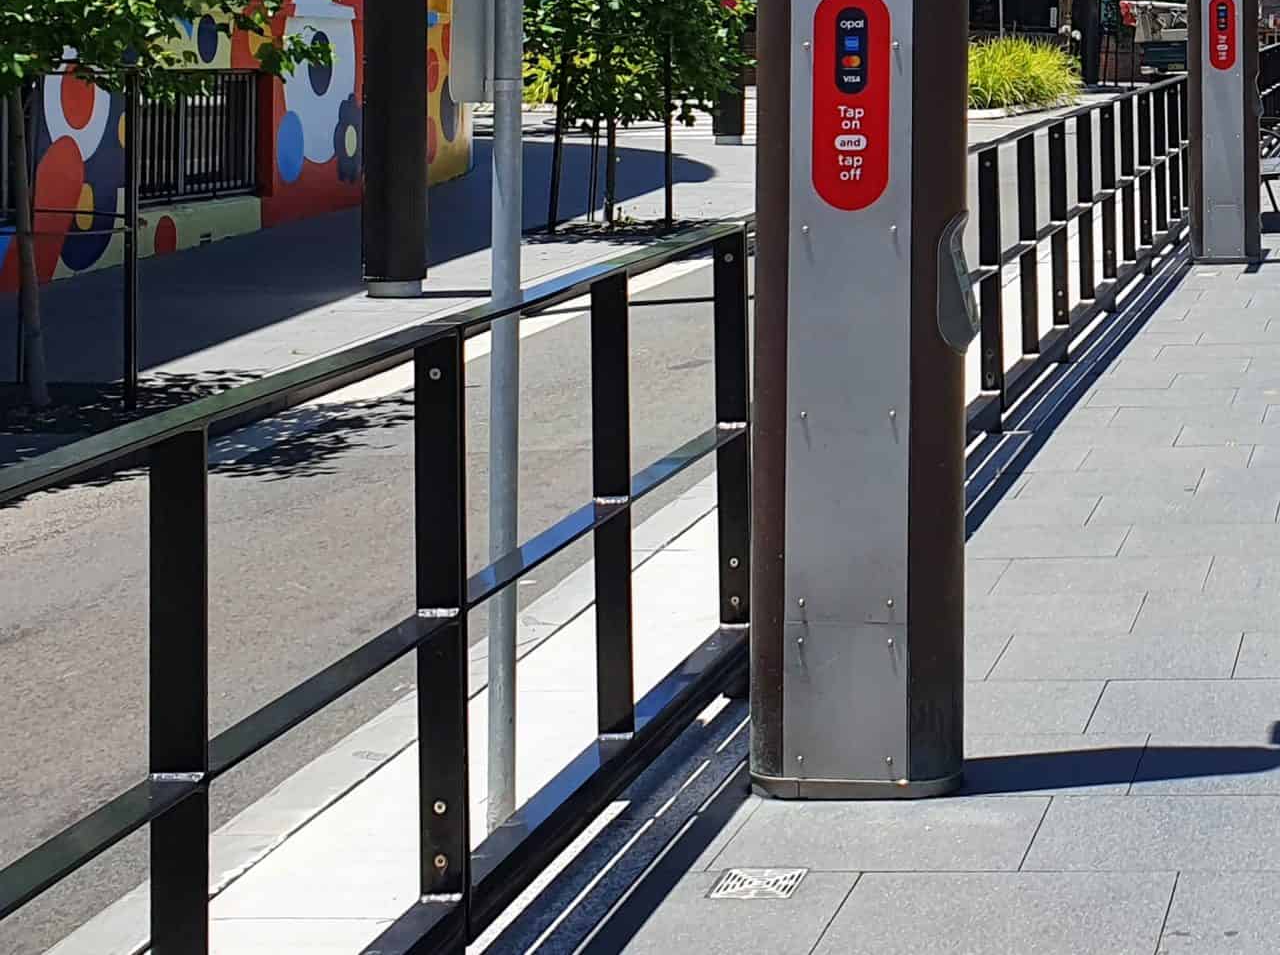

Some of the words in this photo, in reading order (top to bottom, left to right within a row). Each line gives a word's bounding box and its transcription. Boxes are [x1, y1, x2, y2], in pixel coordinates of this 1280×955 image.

[840, 19, 864, 30] opal
[843, 75, 861, 83] VISA
[837, 105, 865, 119] Tap
[841, 119, 861, 130] on
[839, 137, 862, 147] and
[838, 154, 863, 167] tap
[839, 168, 862, 181] off
